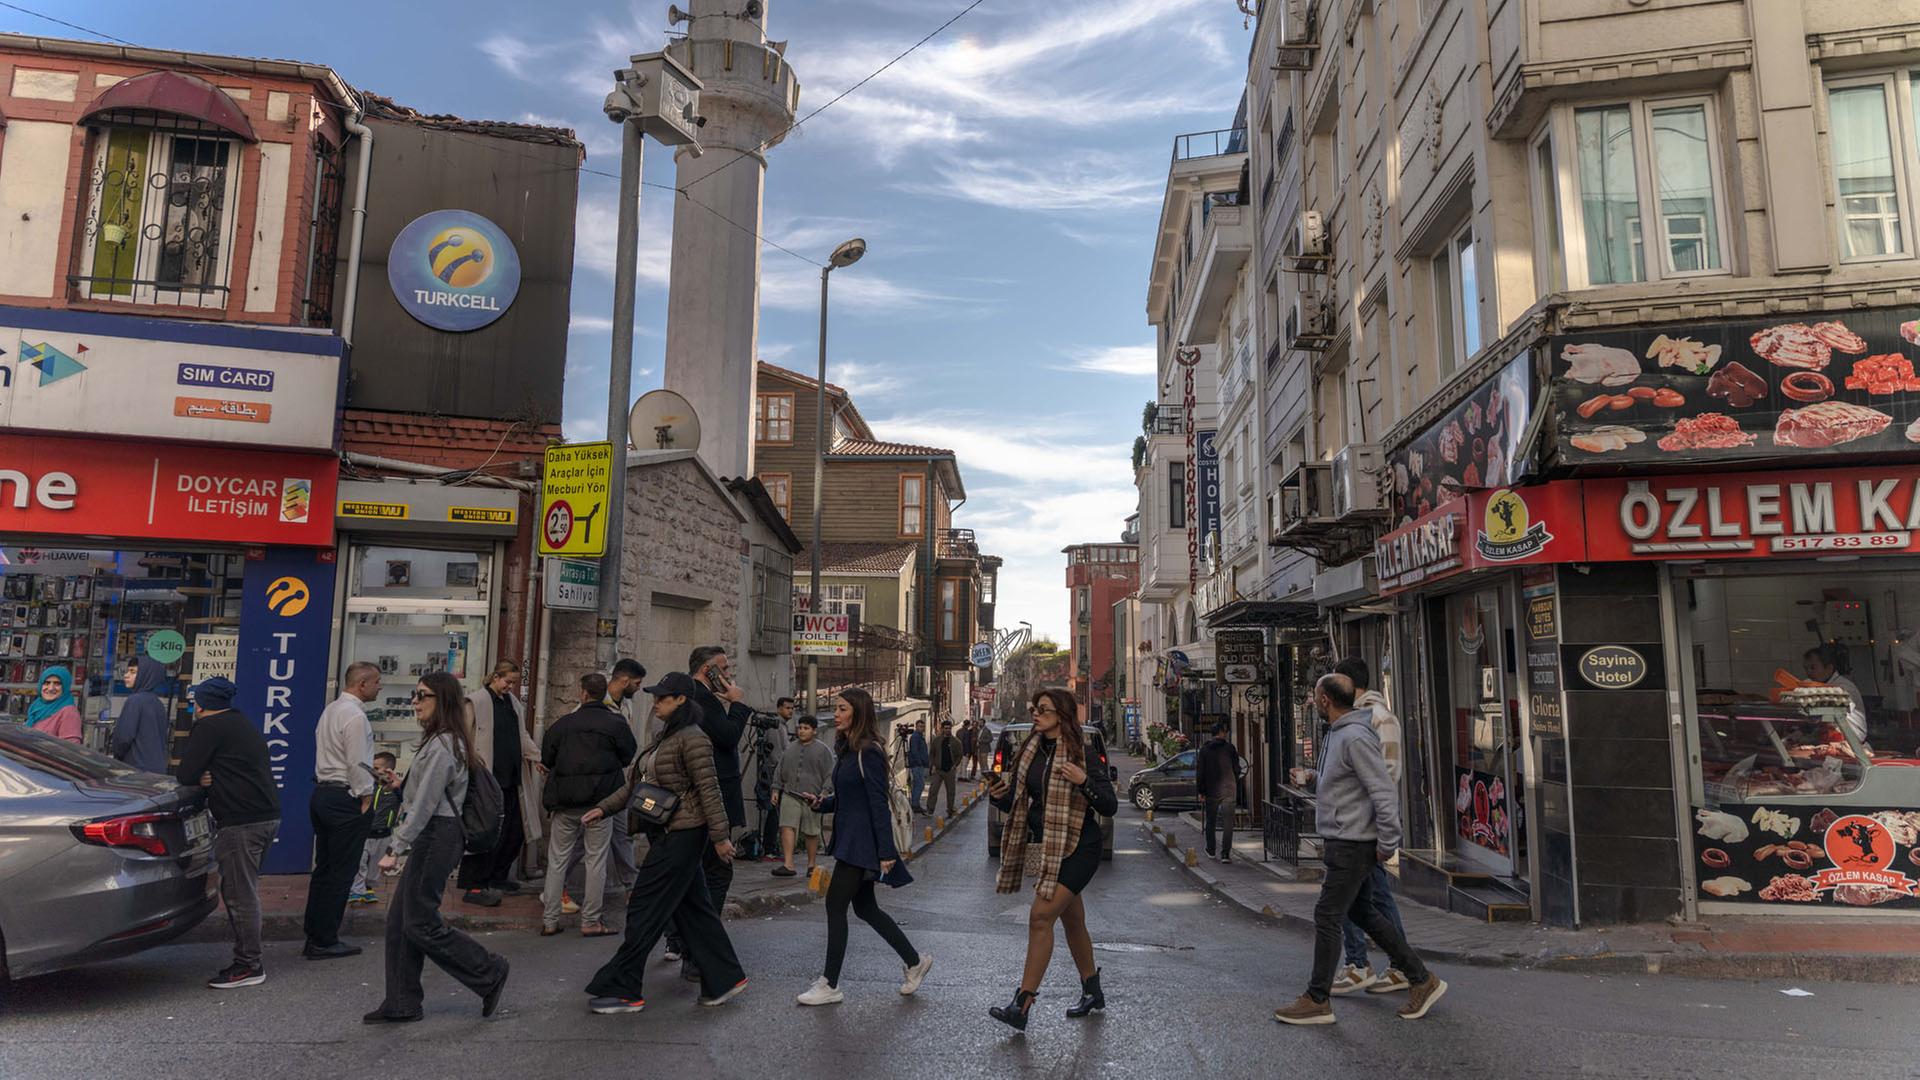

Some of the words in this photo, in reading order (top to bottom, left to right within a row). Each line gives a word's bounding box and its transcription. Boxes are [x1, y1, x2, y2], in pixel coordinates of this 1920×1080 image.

[414, 289, 500, 311] TURKCELL
[182, 367, 215, 382] SIM
[220, 370, 271, 387] CARD
[1183, 368, 1196, 448] KUMLUK
[548, 451, 572, 463] Daha
[574, 449, 609, 460] Yüksek
[550, 466, 584, 480] Araçlar
[586, 463, 604, 479] İçin
[177, 475, 277, 498] DOYCAR
[547, 483, 585, 495] Mecburi
[587, 481, 605, 493] Yön
[1186, 453, 1197, 521] KONAK
[188, 495, 268, 518] İLETİŞİM
[1207, 468, 1217, 531] HOTE
[1620, 479, 1837, 540] ÖZLEM
[1410, 513, 1455, 568] KASAP
[1507, 540, 1533, 554] KASAP
[1783, 537, 1824, 549] 517
[1833, 536, 1862, 548] 83
[1871, 535, 1899, 547] 89
[42, 552, 90, 561] HUAWEI
[1187, 527, 1198, 595] HOTEL
[806, 616, 835, 632] WC
[207, 649, 227, 657] SIM
[1219, 654, 1238, 664] OLD
[1588, 654, 1636, 668] Sayina
[1595, 671, 1632, 682] Hotel
[1531, 695, 1560, 717] Gloria
[1828, 871, 1860, 883] ÖZLEM
[1862, 872, 1896, 884] KASAP
